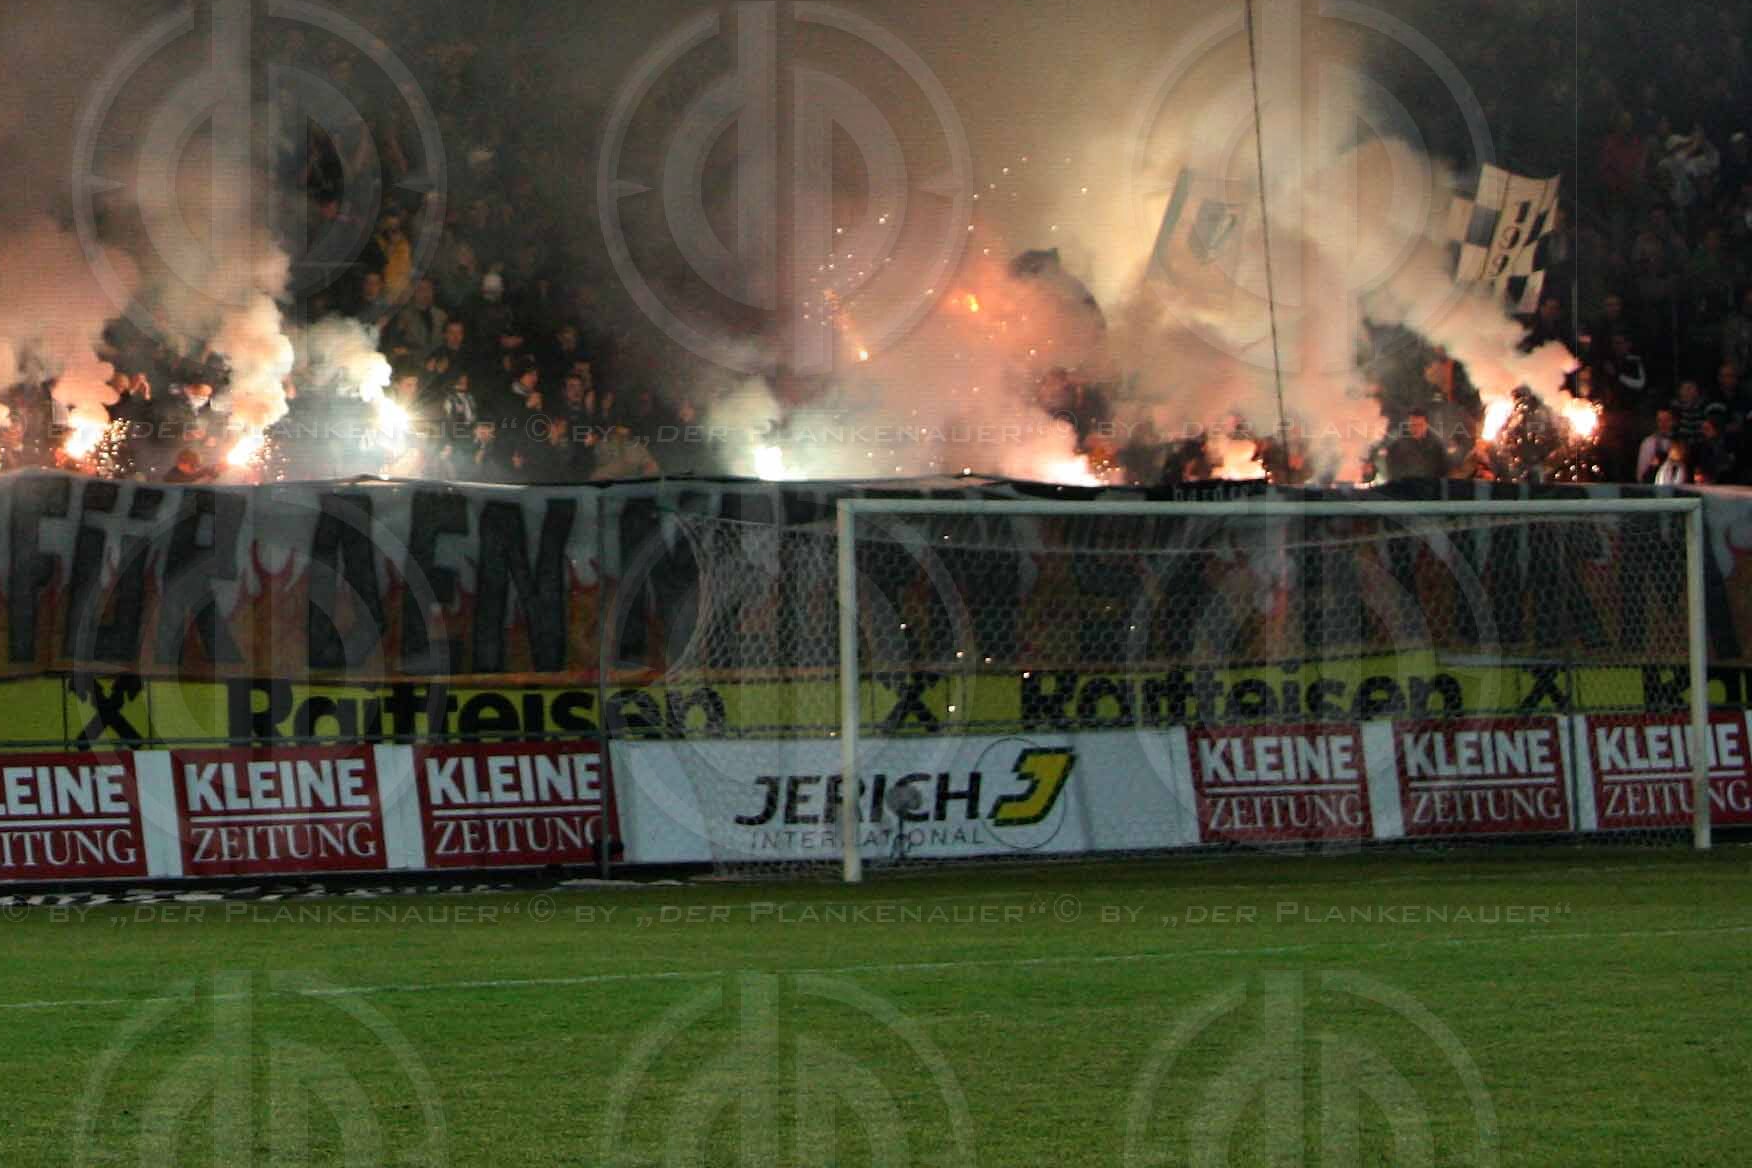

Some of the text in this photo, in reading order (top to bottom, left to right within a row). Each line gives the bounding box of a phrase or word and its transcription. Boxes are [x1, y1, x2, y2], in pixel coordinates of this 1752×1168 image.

[1197, 734, 1359, 783] KLEINE
[1400, 730, 1556, 775] KLEINE
[184, 754, 370, 812] KLEINE
[426, 752, 602, 806] KLEINE
[734, 771, 984, 827] JERICH
[1209, 792, 1365, 832] ZEITUNG
[1412, 787, 1563, 826] ZEITUNG
[191, 820, 377, 863] ZEITUNG
[433, 814, 603, 854] ZEITUNG
[751, 827, 985, 850] INTERATONAL
